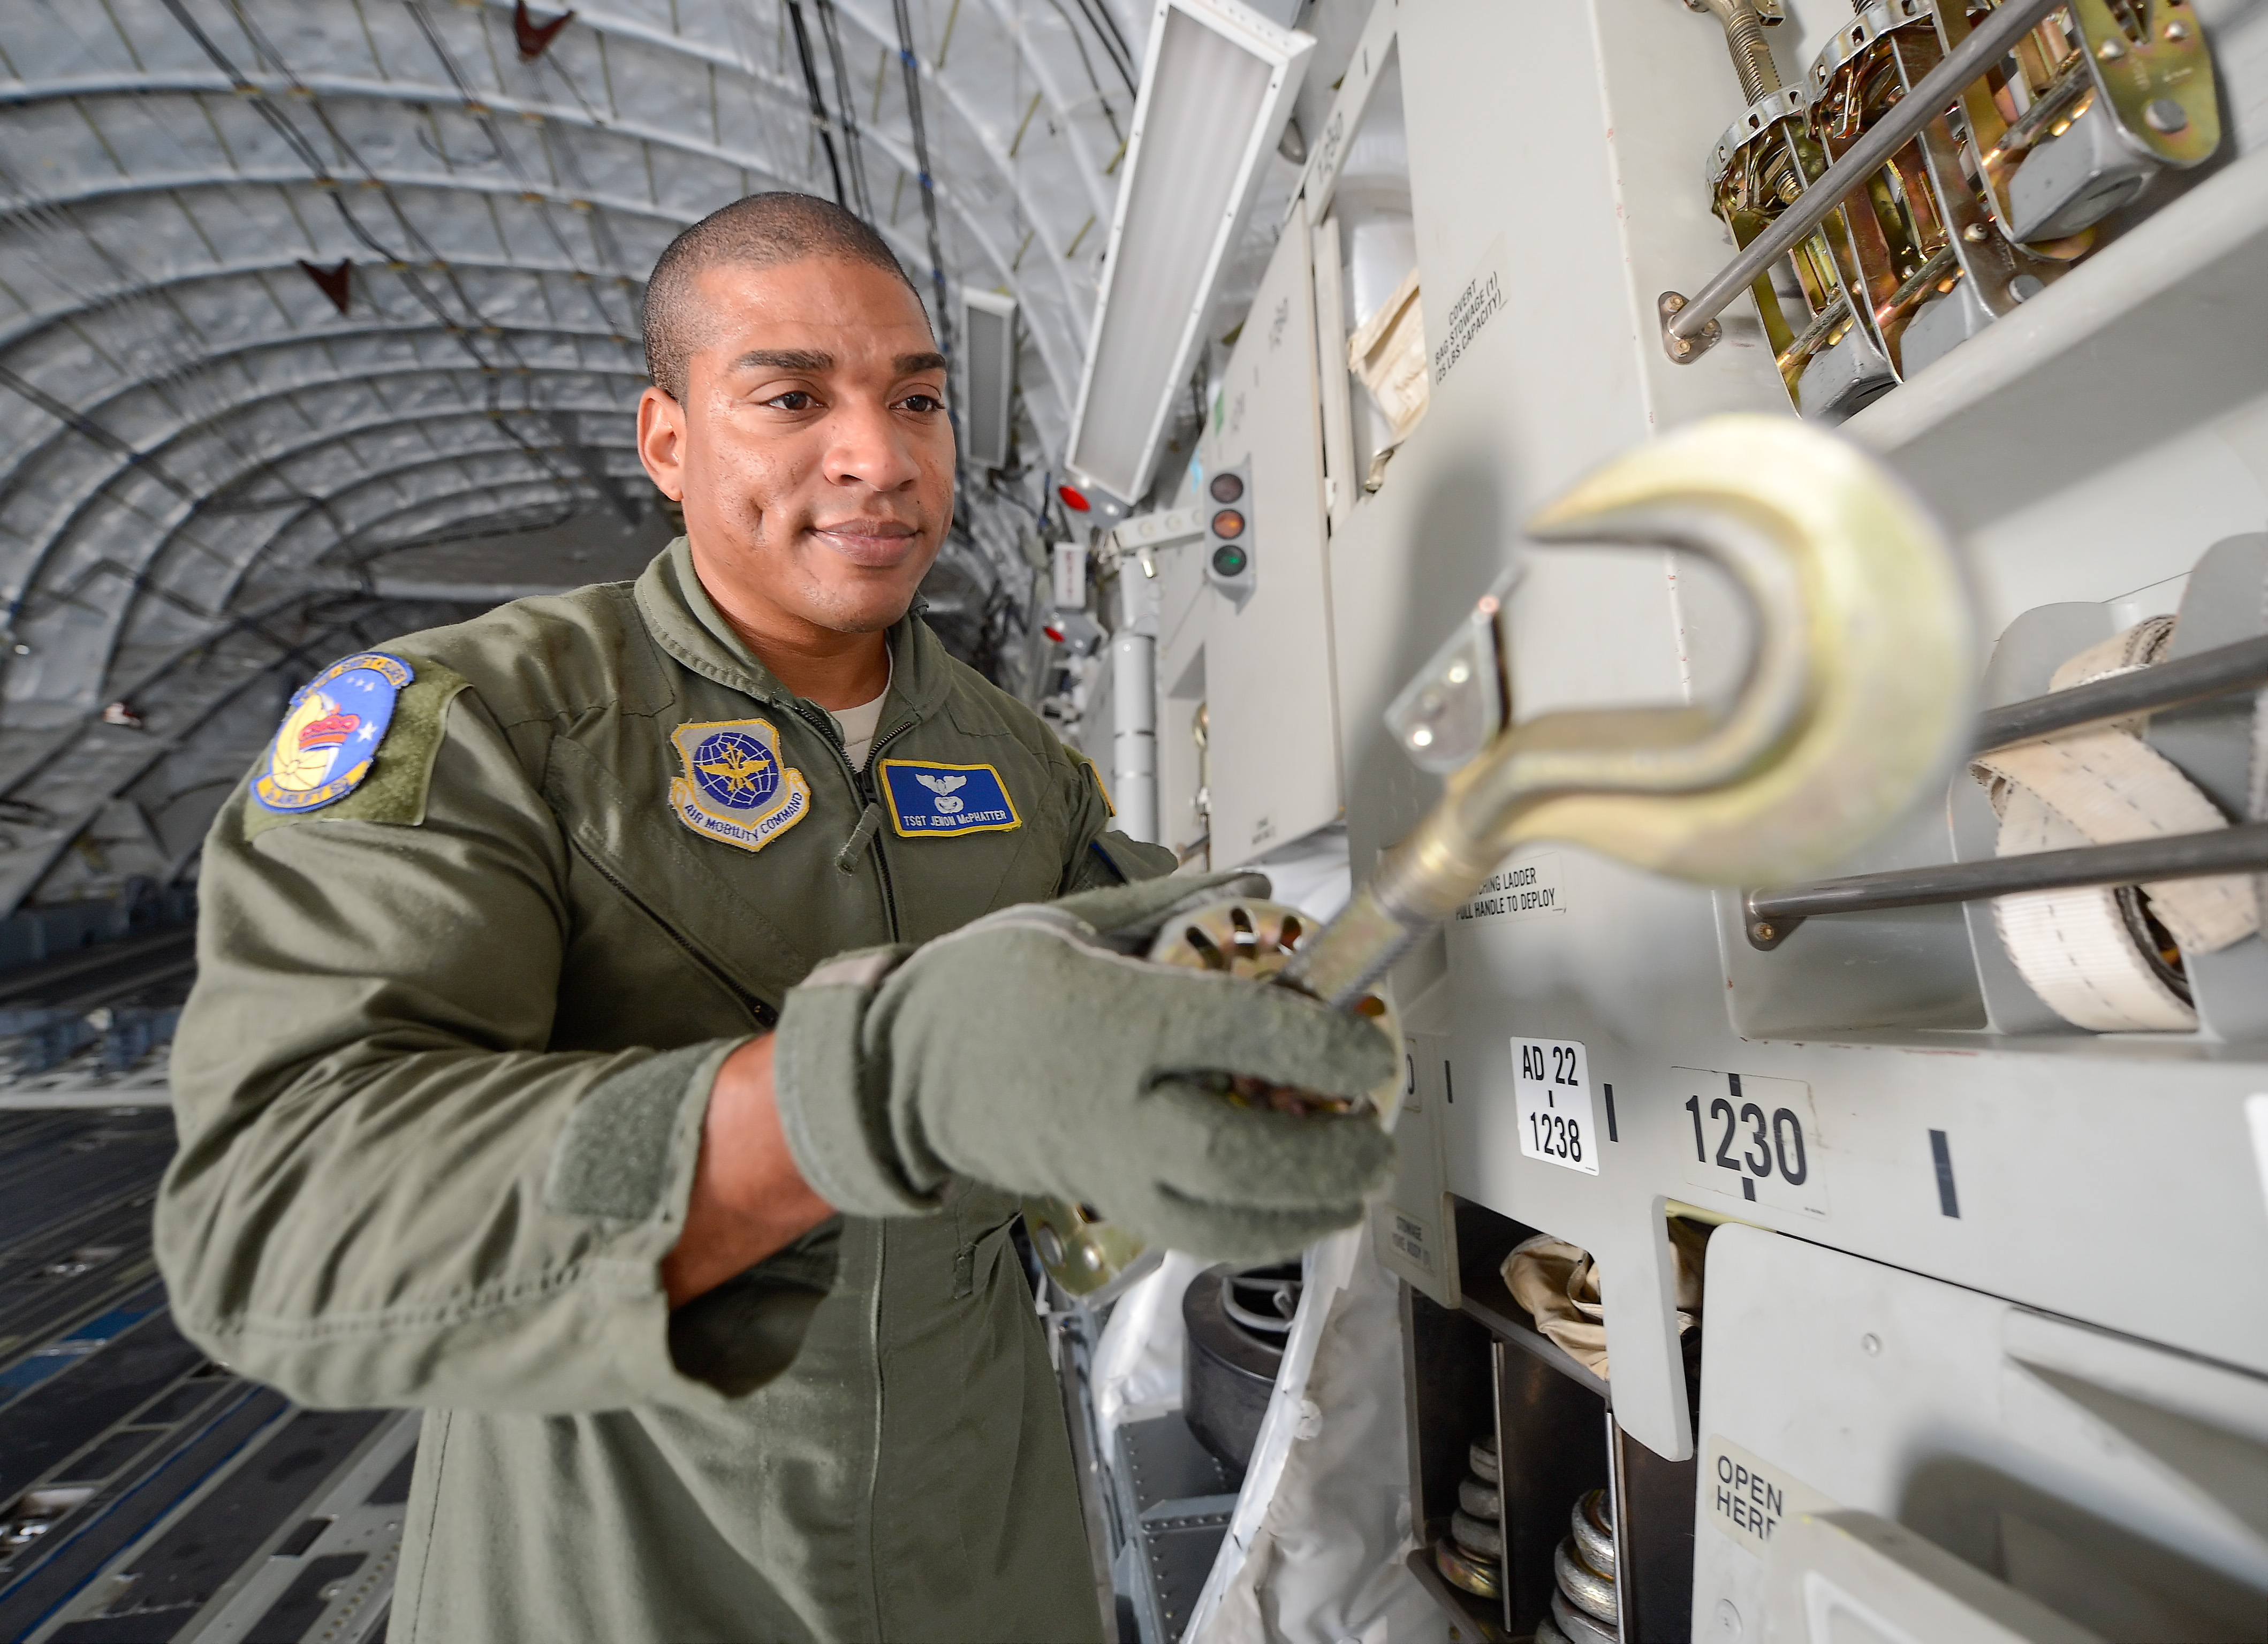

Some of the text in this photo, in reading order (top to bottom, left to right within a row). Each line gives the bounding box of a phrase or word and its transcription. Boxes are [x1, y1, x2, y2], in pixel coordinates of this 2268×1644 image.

[1435, 271, 1497, 366] BAG STOWAGE (1)
[1448, 278, 1476, 326] COVERT
[1447, 344, 1460, 369] LBS
[1462, 288, 1501, 349] CAPACITY)
[685, 793, 802, 841] AIR MOBILITY COMMAND
[904, 816, 926, 826] TSGT
[957, 810, 1007, 825] McPHATTER
[1503, 867, 1536, 889] LADDER
[1474, 897, 1505, 918] HANDLE
[1507, 895, 1518, 912] TO
[1521, 888, 1555, 910] DEPLOY
[1523, 1045, 1579, 1086] AD 22
[1530, 1112, 1582, 1162] 1238
[1686, 1094, 1807, 1186] 1230
[1718, 1455, 1782, 1517] OPEN
